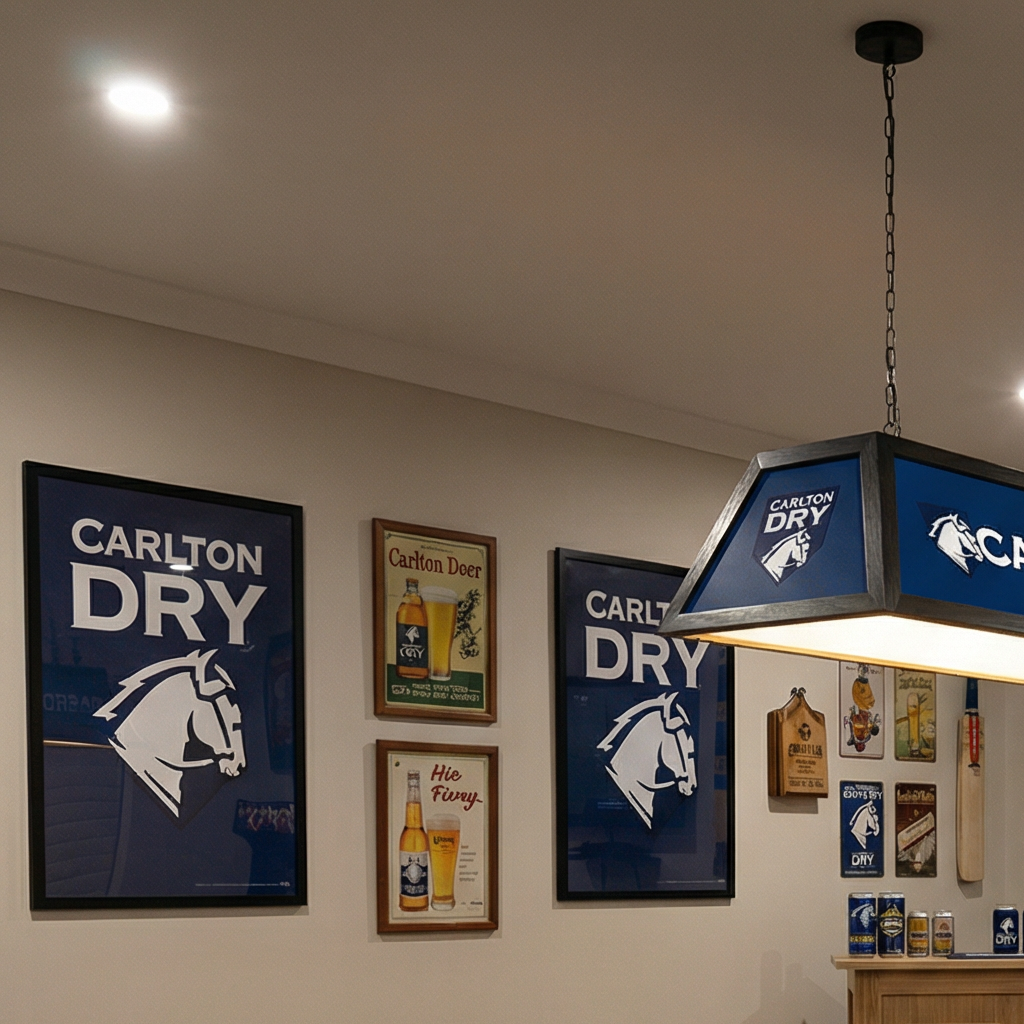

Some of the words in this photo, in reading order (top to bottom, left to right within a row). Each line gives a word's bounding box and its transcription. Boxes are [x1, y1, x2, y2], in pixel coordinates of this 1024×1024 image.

[763, 503, 831, 533] DRY
[770, 491, 835, 511] CARLTON
[71, 518, 263, 575] CARLTON
[389, 547, 444, 574] Carlton
[70, 562, 268, 645] DRY
[585, 590, 670, 626] CARLT
[585, 625, 710, 689] DRY
